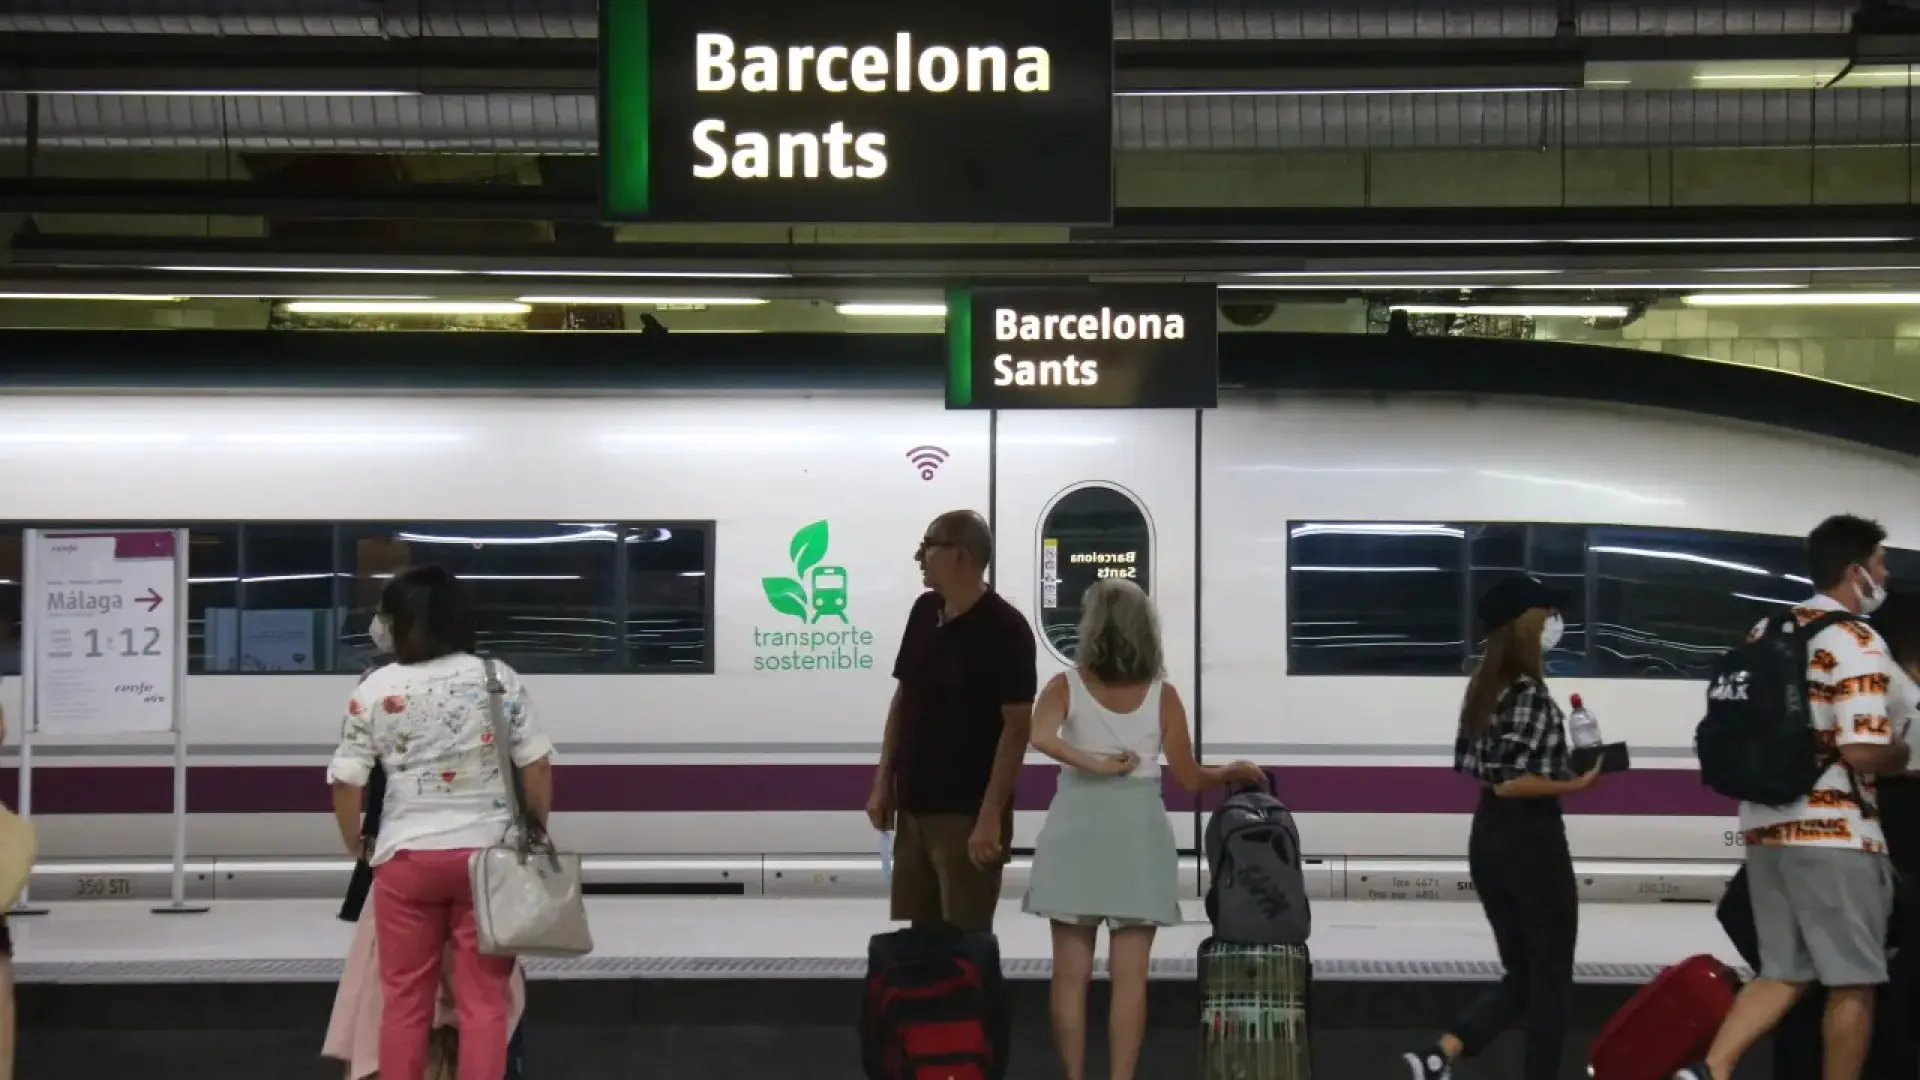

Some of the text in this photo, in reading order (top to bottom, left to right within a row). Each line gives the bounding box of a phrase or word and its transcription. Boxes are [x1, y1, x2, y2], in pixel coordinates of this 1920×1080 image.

[695, 32, 1051, 93] Barcelona
[692, 118, 889, 179] Sants
[995, 306, 1185, 340] Barcelona
[993, 353, 1099, 387] Sants
[46, 590, 123, 614] Málaga
[84, 628, 103, 658] 1
[119, 626, 161, 657] 12
[753, 626, 874, 651] transporte
[753, 646, 874, 671] sostenible
